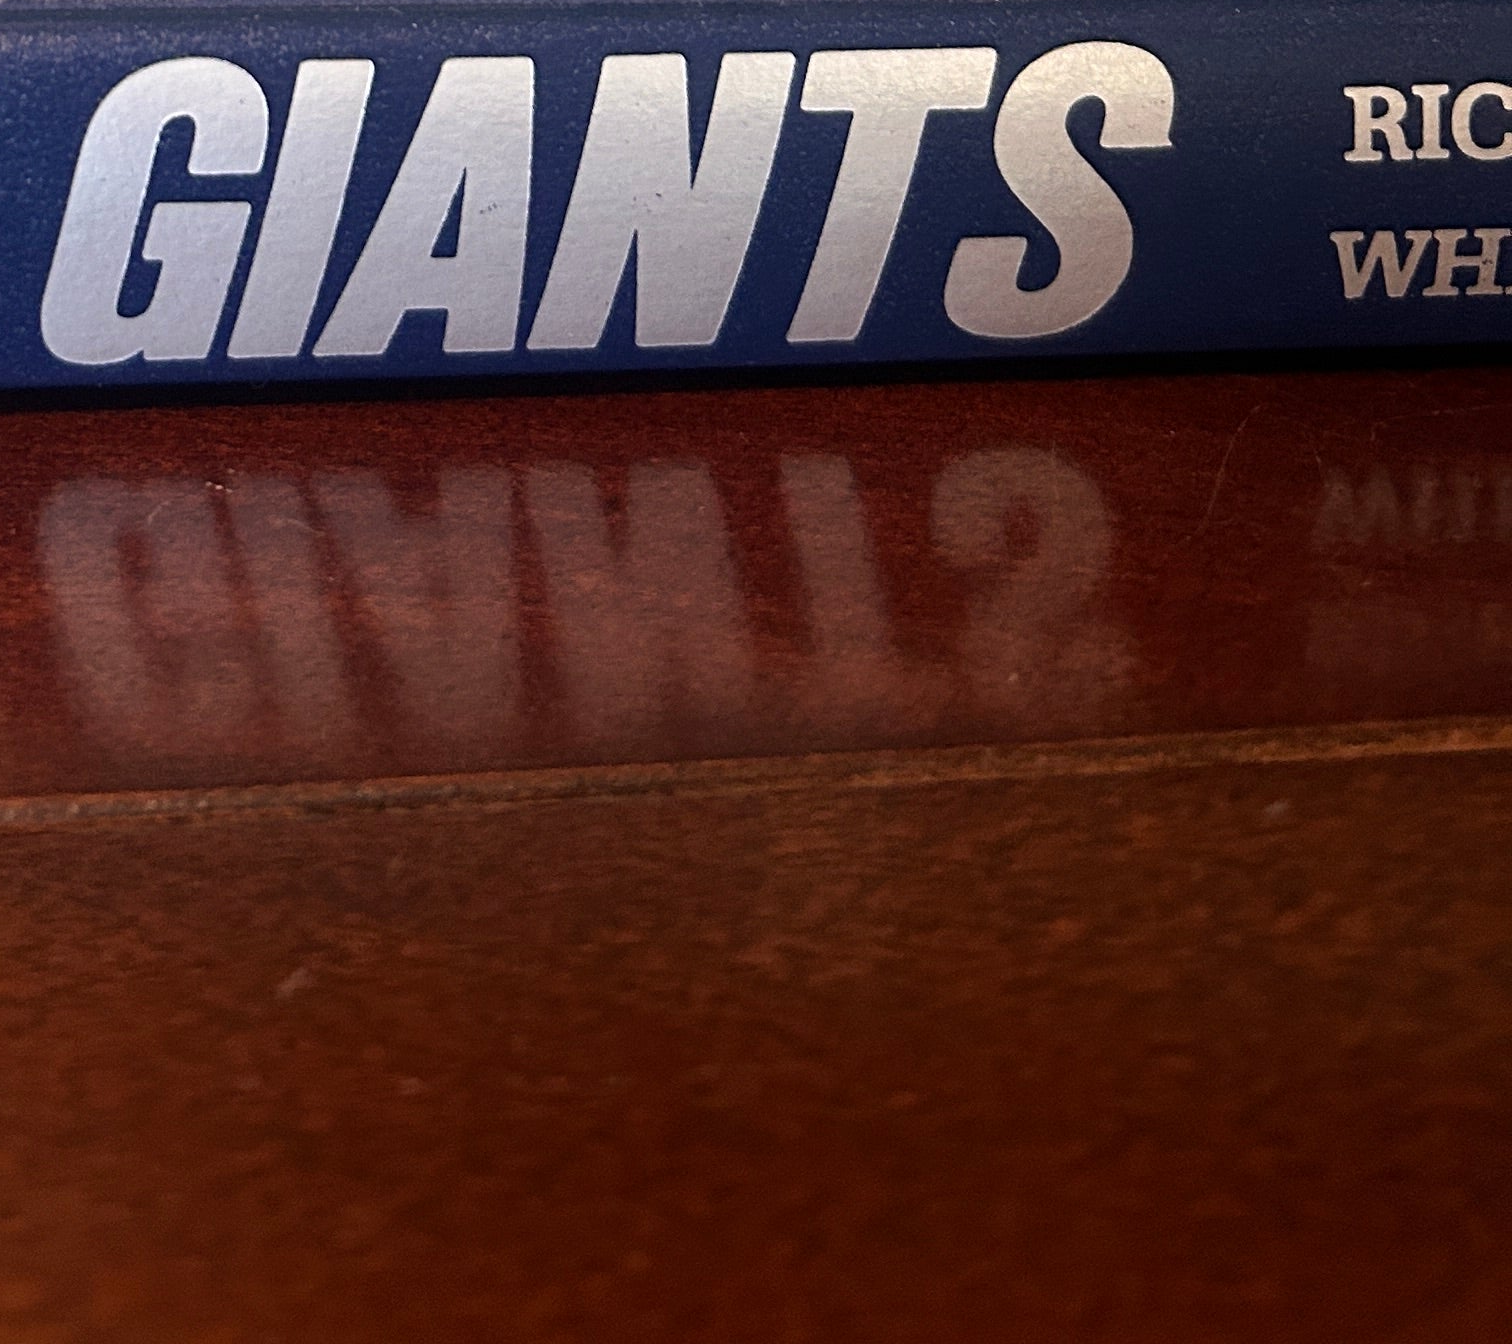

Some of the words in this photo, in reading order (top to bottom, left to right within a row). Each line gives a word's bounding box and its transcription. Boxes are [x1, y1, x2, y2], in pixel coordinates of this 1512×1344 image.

[1343, 81, 1512, 162] RIC
[39, 42, 1177, 367] GIANTS
[1329, 227, 1512, 300] WH
